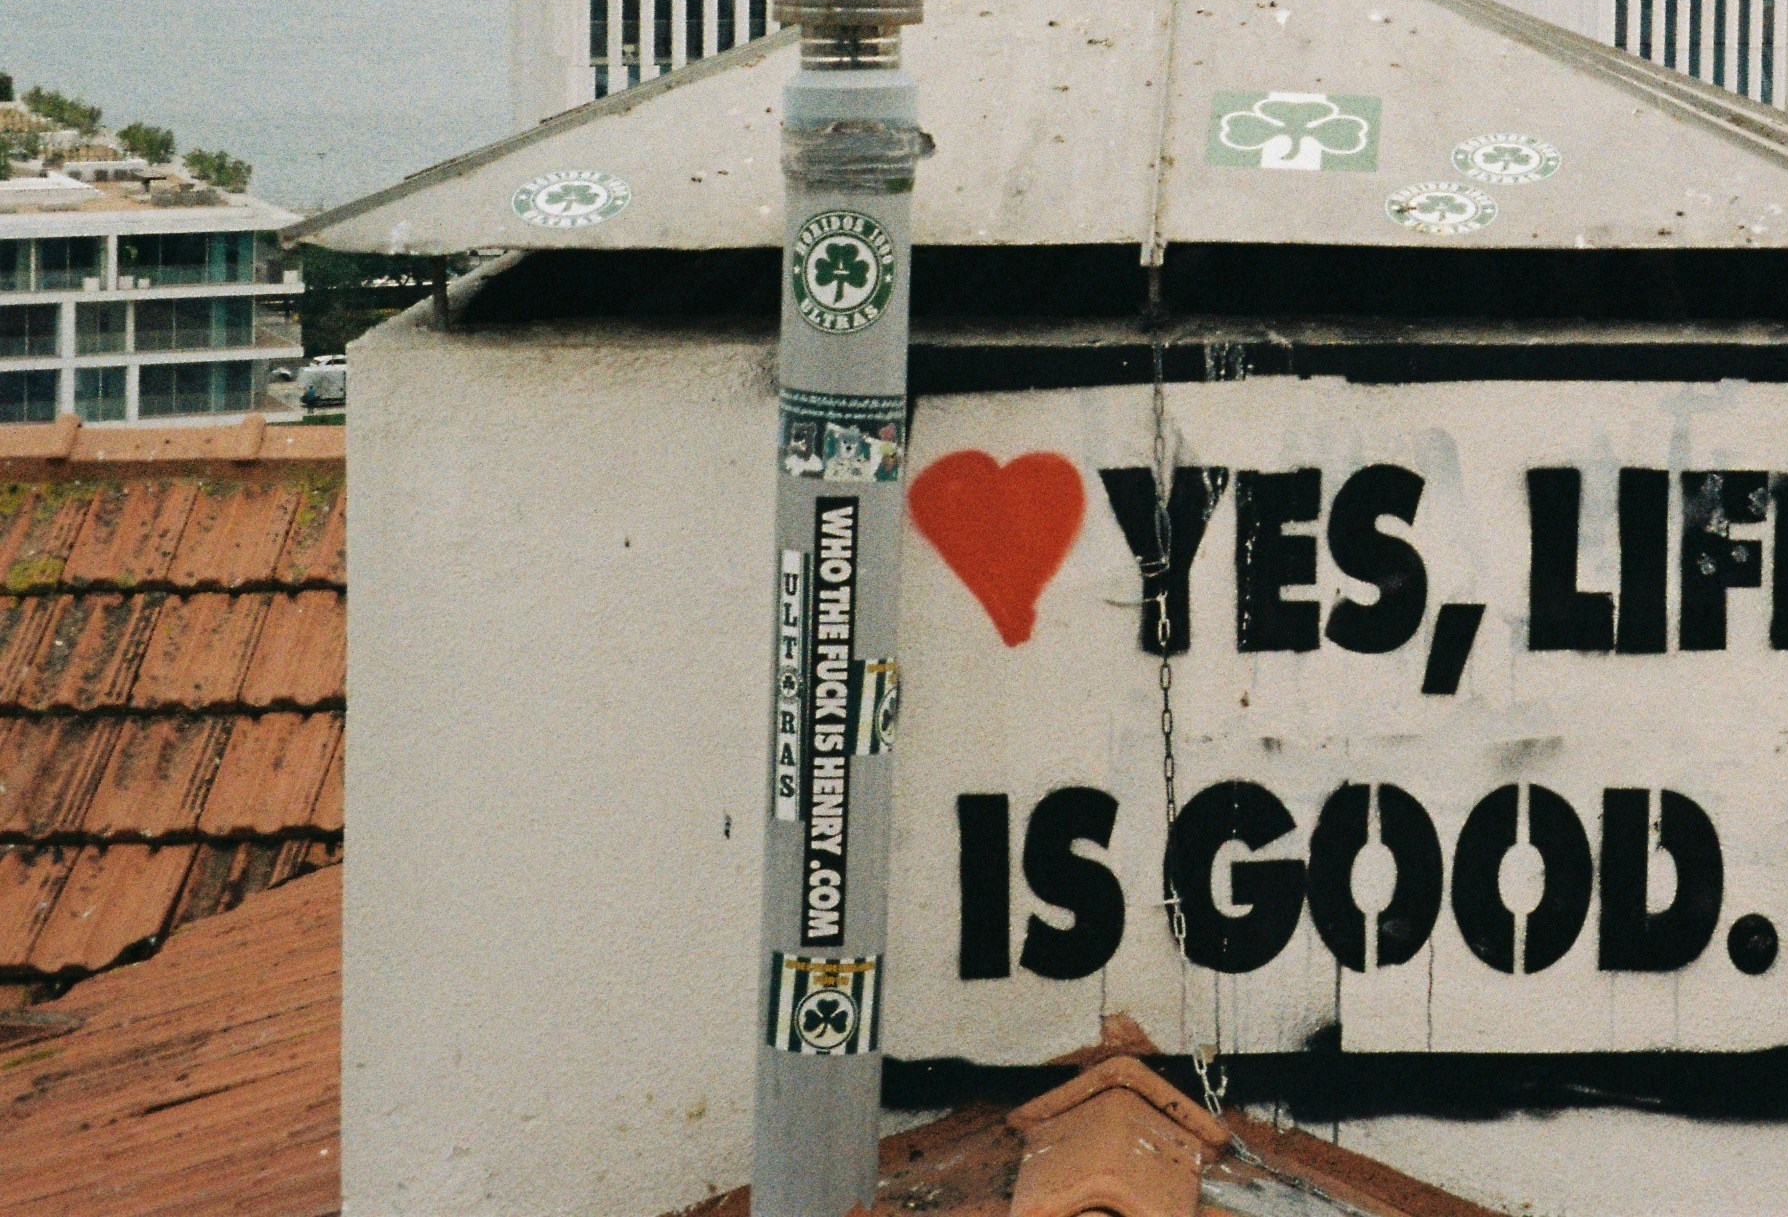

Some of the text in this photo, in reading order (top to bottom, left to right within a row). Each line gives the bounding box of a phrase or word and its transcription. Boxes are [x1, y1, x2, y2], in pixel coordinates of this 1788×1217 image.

[801, 297, 879, 329] ULTRAS
[820, 506, 853, 583] WHO
[1099, 463, 1487, 695] YES,
[818, 586, 851, 640] THE
[815, 644, 849, 720] FUCK
[813, 723, 846, 752] IS
[810, 756, 846, 856] HENRY
[807, 859, 842, 938] .COM
[957, 780, 1779, 980] IS GOOD.
